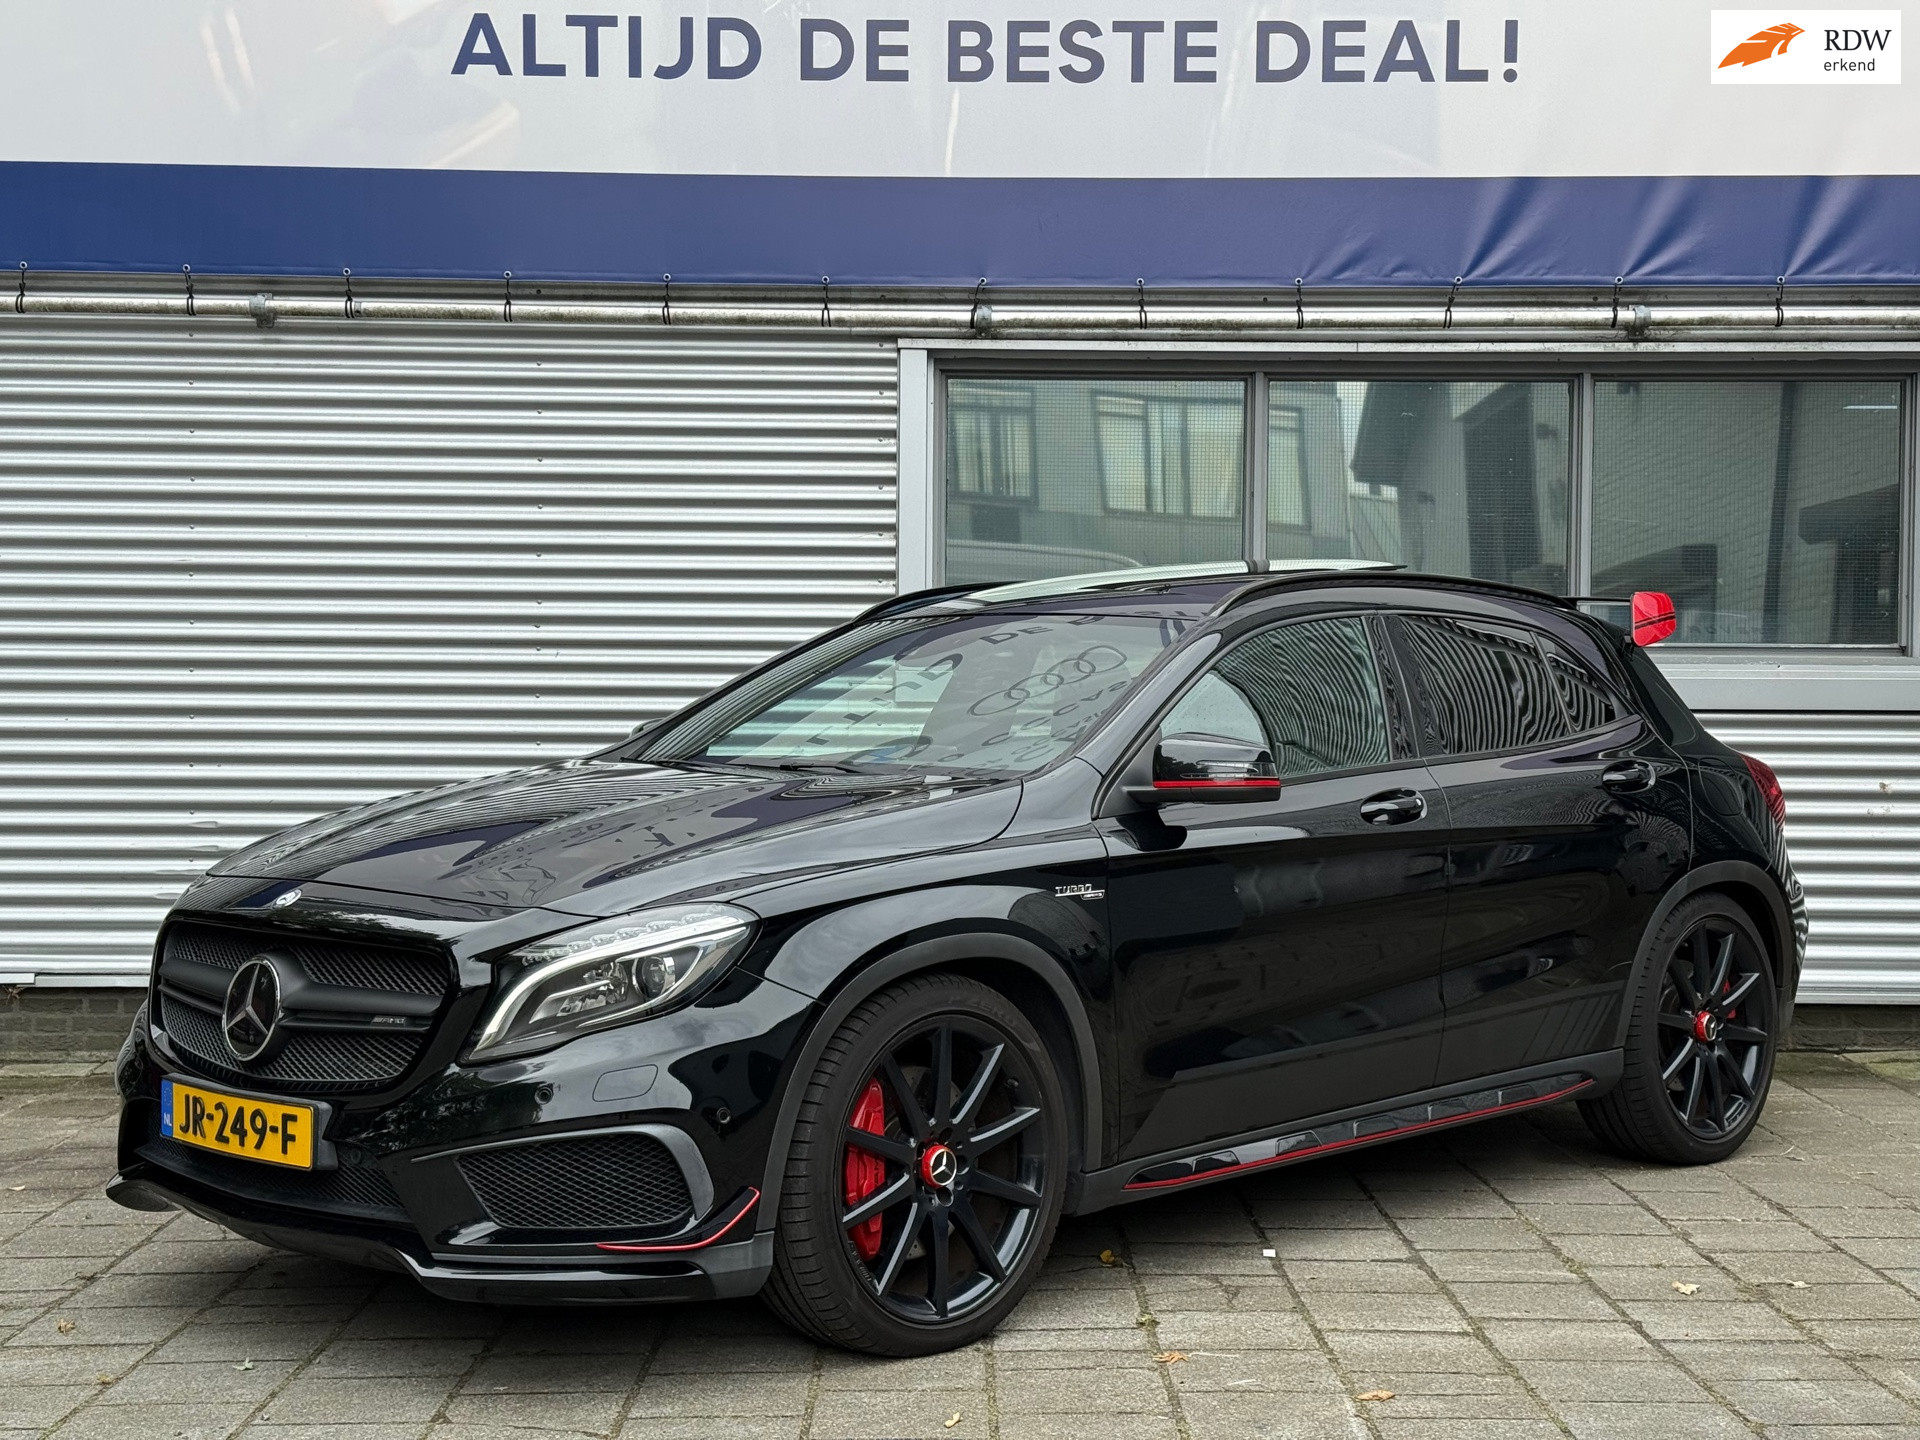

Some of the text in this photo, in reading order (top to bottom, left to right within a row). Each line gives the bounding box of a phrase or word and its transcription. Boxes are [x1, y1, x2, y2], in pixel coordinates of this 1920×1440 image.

[451, 12, 1519, 84] ALTIJD DE BESTE DEAL!
[1055, 883, 1092, 895] TURBO
[163, 1112, 172, 1127] NL
[179, 1093, 298, 1155] JR-249-F
